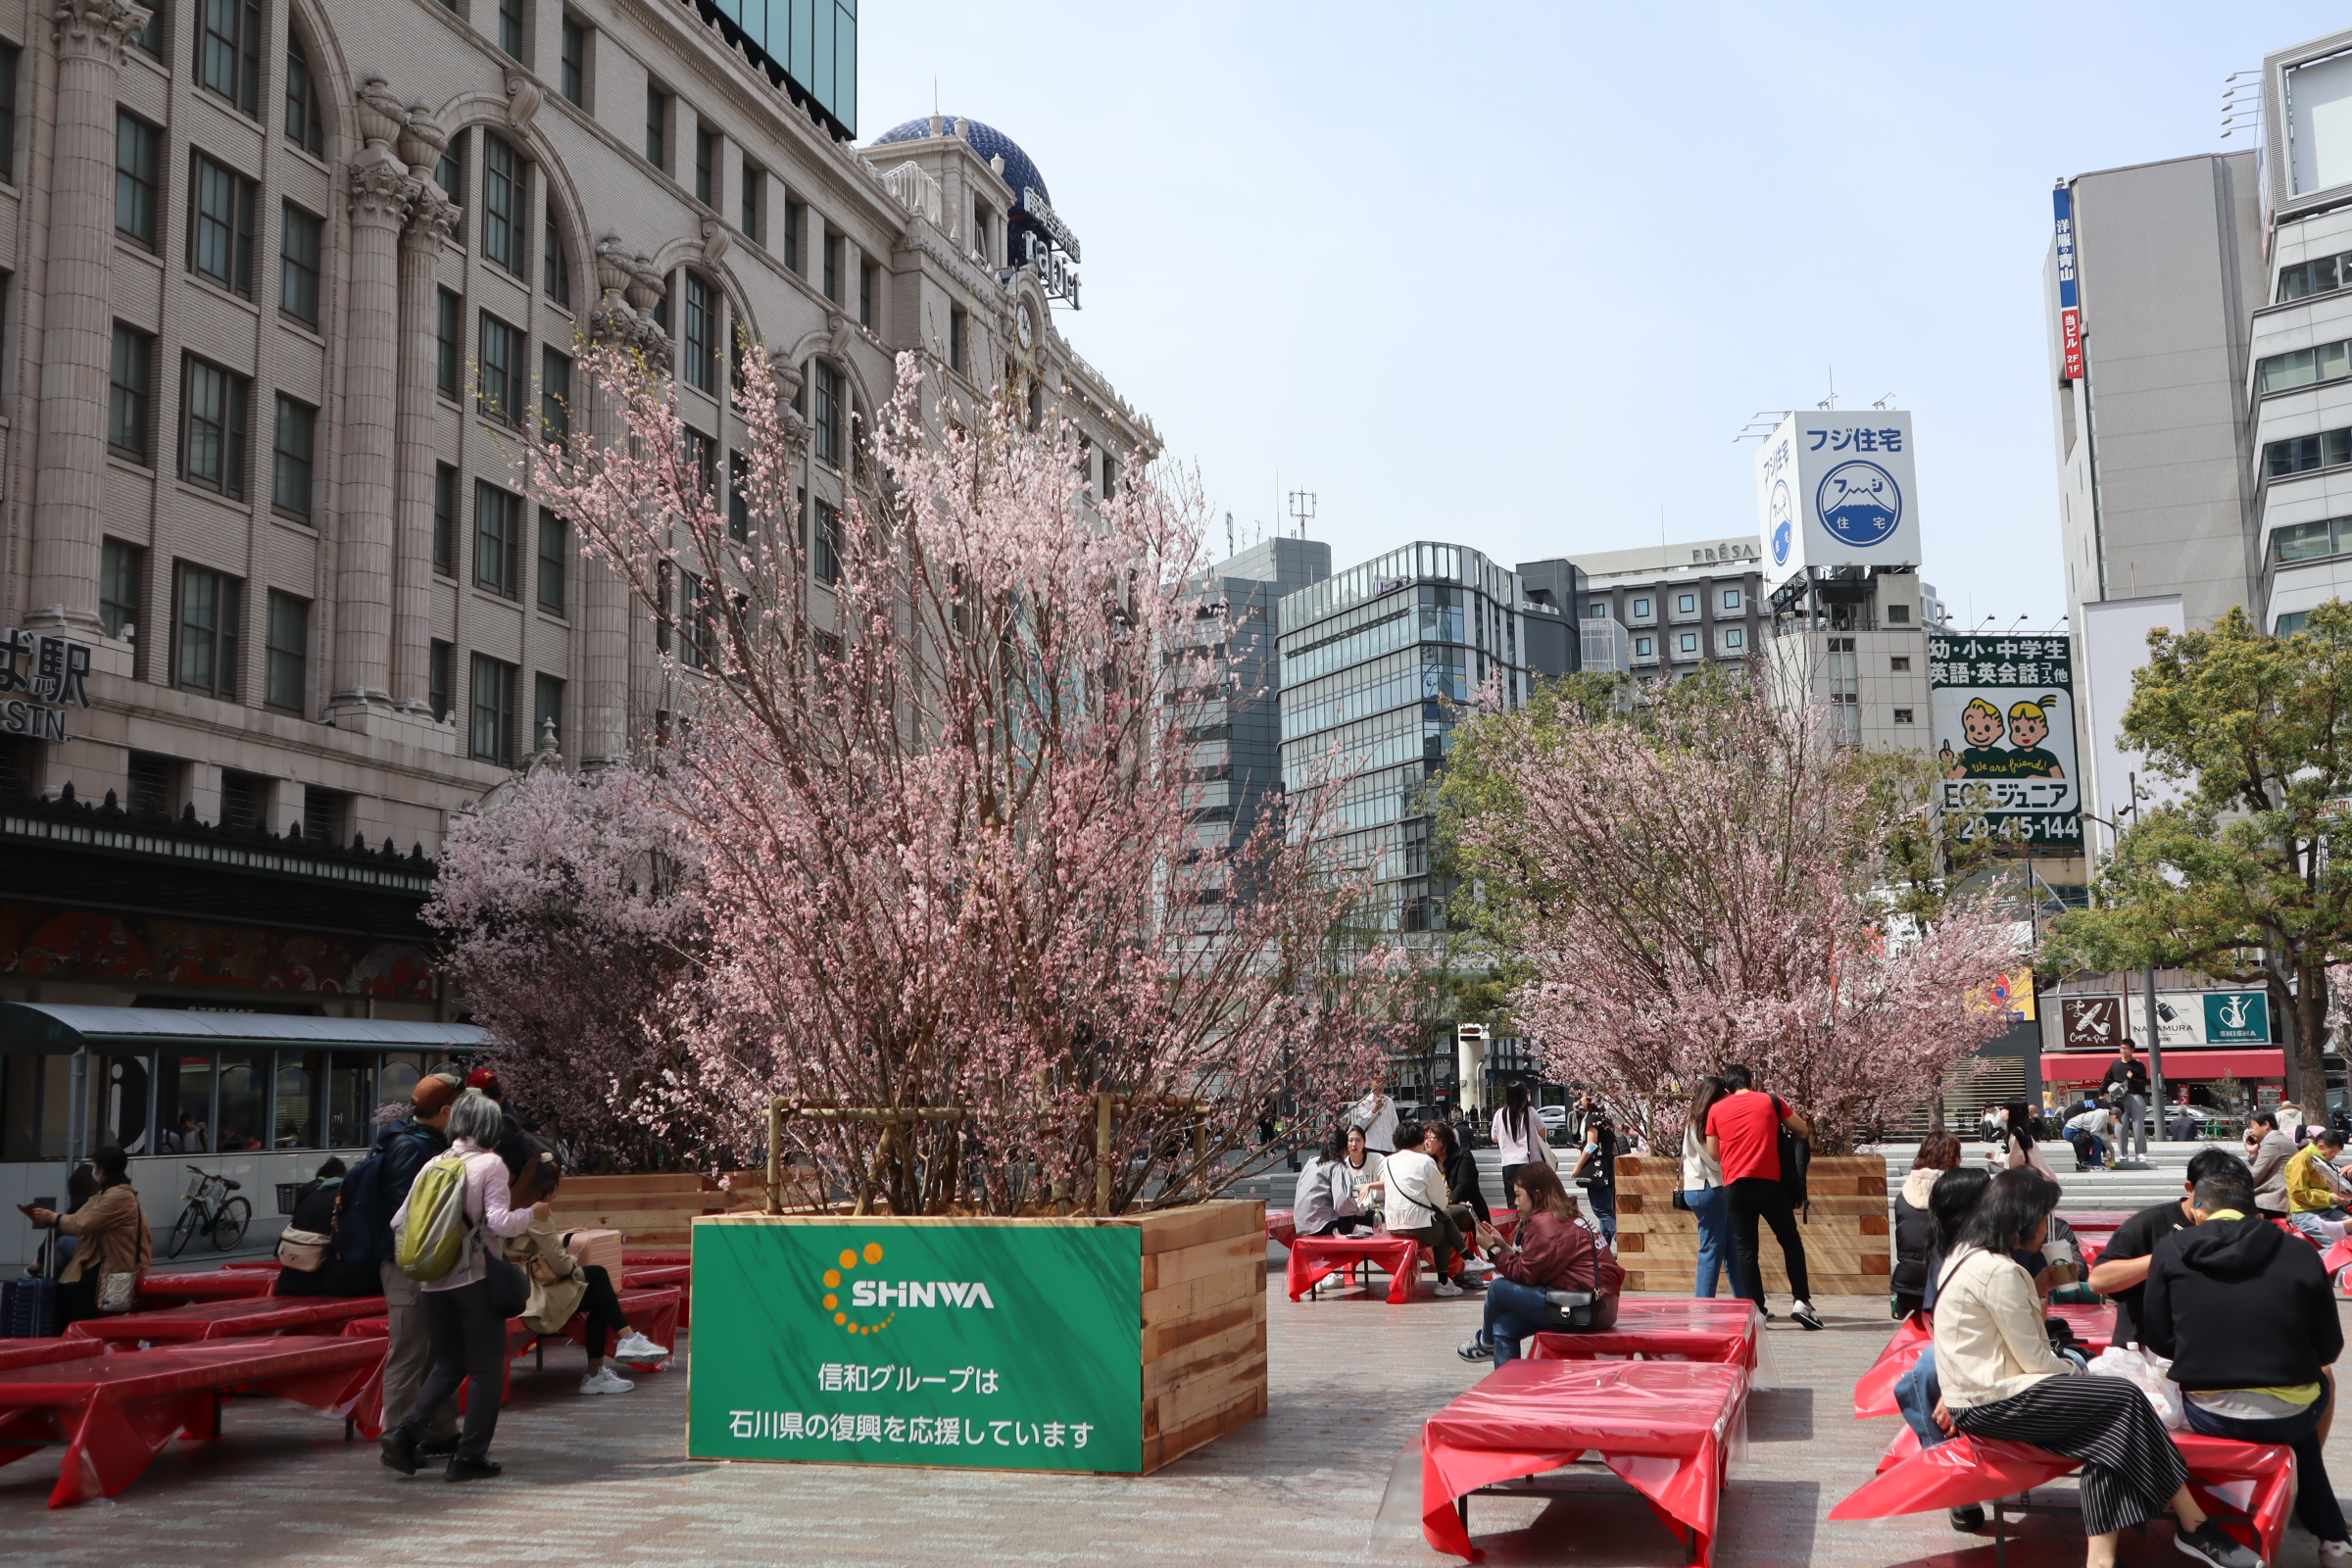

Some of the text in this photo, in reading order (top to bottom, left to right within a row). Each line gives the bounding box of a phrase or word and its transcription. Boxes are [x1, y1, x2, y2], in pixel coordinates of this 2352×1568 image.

[2056, 219, 2074, 281] 洋服の青山
[2065, 315, 2078, 349] 当ビル
[2067, 354, 2079, 364] 2F
[2069, 365, 2080, 373] 1F
[1807, 428, 1902, 452] フジ住宅
[1930, 640, 2067, 660] 幼・小・中学生
[5, 700, 72, 743] STN.
[1972, 761, 1987, 772] We
[2009, 759, 2046, 773] friends!
[852, 1281, 995, 1308] SHINWA
[818, 1363, 999, 1394] 信和グループは
[728, 1410, 1094, 1449] 石川県の復興を応援しています
